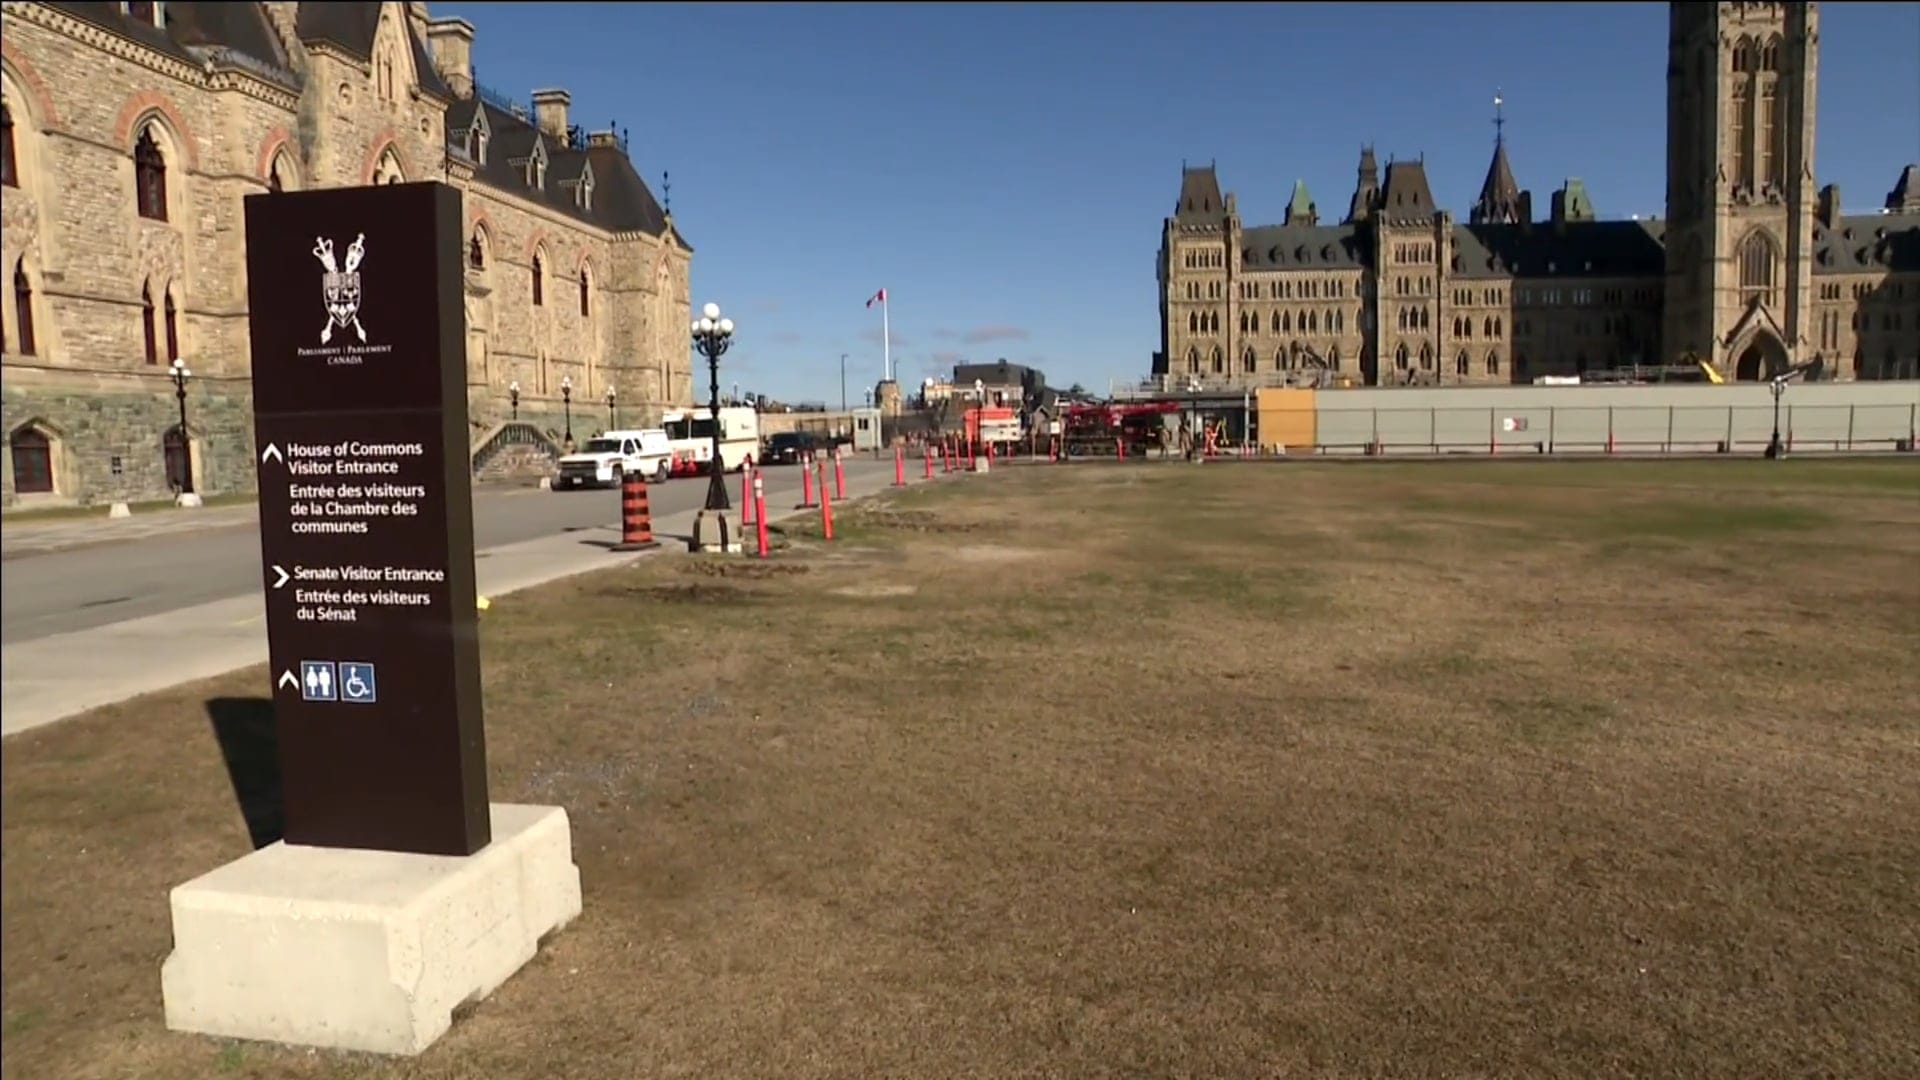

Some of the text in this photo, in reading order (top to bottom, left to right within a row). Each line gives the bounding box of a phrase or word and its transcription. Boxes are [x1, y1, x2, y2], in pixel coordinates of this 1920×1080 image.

[297, 345, 392, 356] PARLIAMENT PARLEMENT
[327, 356, 362, 364] CANADA
[288, 442, 423, 457] House of Commons
[288, 460, 398, 474] Visitor Entrance
[290, 483, 425, 498] Entrée des visiteurs
[291, 501, 417, 515] de la Chambre des
[292, 522, 368, 533] communes
[294, 566, 444, 581] Senate Visitor Entrance
[296, 589, 430, 604] Entrée des visiteurs
[297, 606, 356, 621] du Sénat
